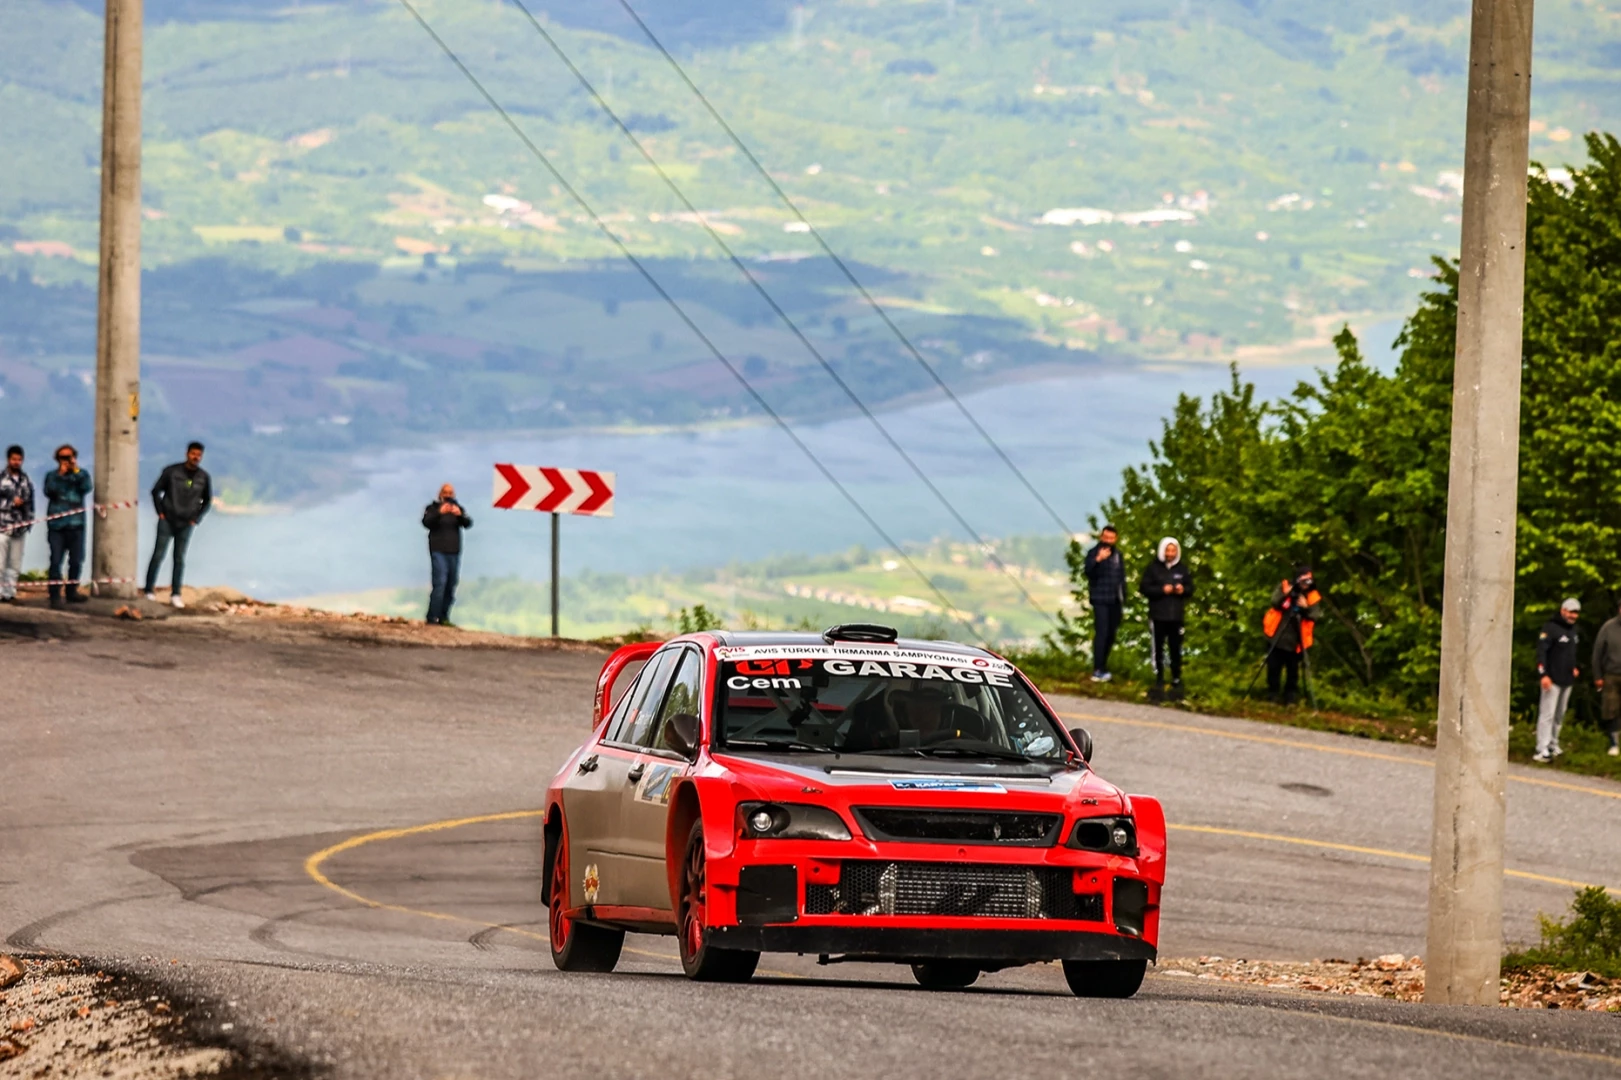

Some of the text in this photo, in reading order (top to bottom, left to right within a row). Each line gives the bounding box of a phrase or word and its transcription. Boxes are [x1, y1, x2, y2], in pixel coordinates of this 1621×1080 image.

[833, 648, 891, 657] TIRMANMA
[823, 660, 1014, 688] GARAGE
[727, 675, 801, 690] Cem
